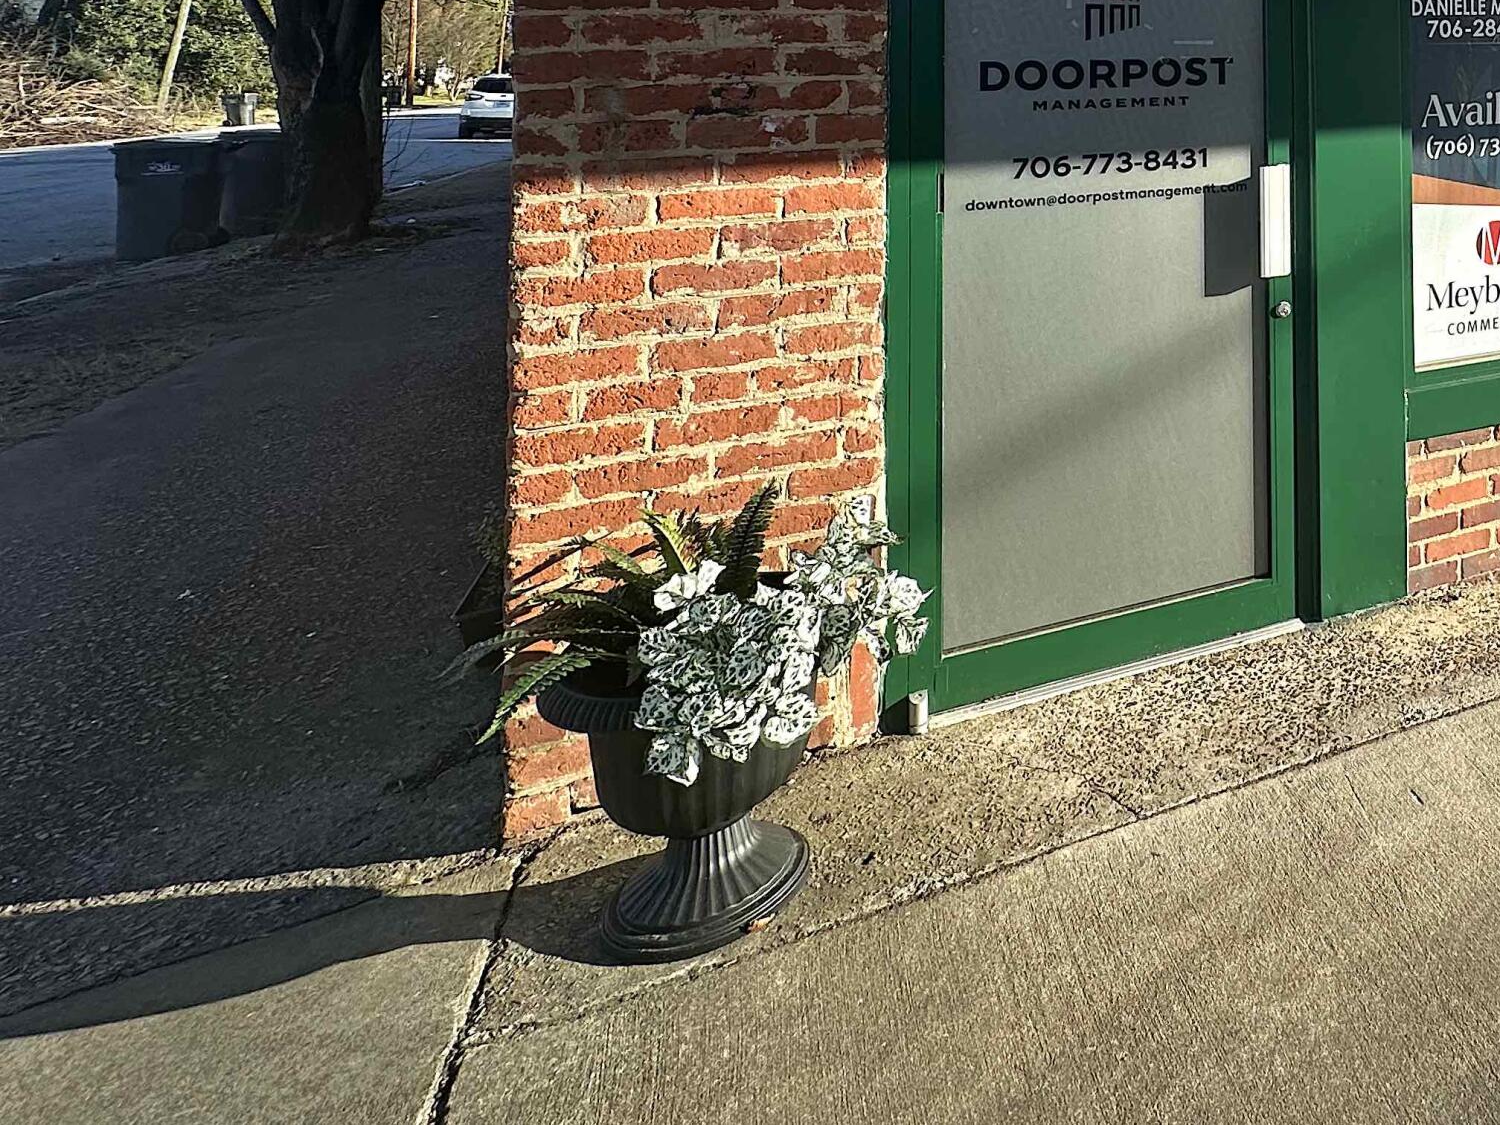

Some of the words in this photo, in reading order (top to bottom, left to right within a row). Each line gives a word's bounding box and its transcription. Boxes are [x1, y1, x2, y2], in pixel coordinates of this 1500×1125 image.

[978, 56, 1234, 92] DOORPOST
[1032, 95, 1190, 111] MANAGEMENT
[1012, 147, 1208, 179] 706-773-8431
[1425, 137, 1475, 160] (706)
[965, 181, 1248, 212] downtown@doorpostmanagement.com
